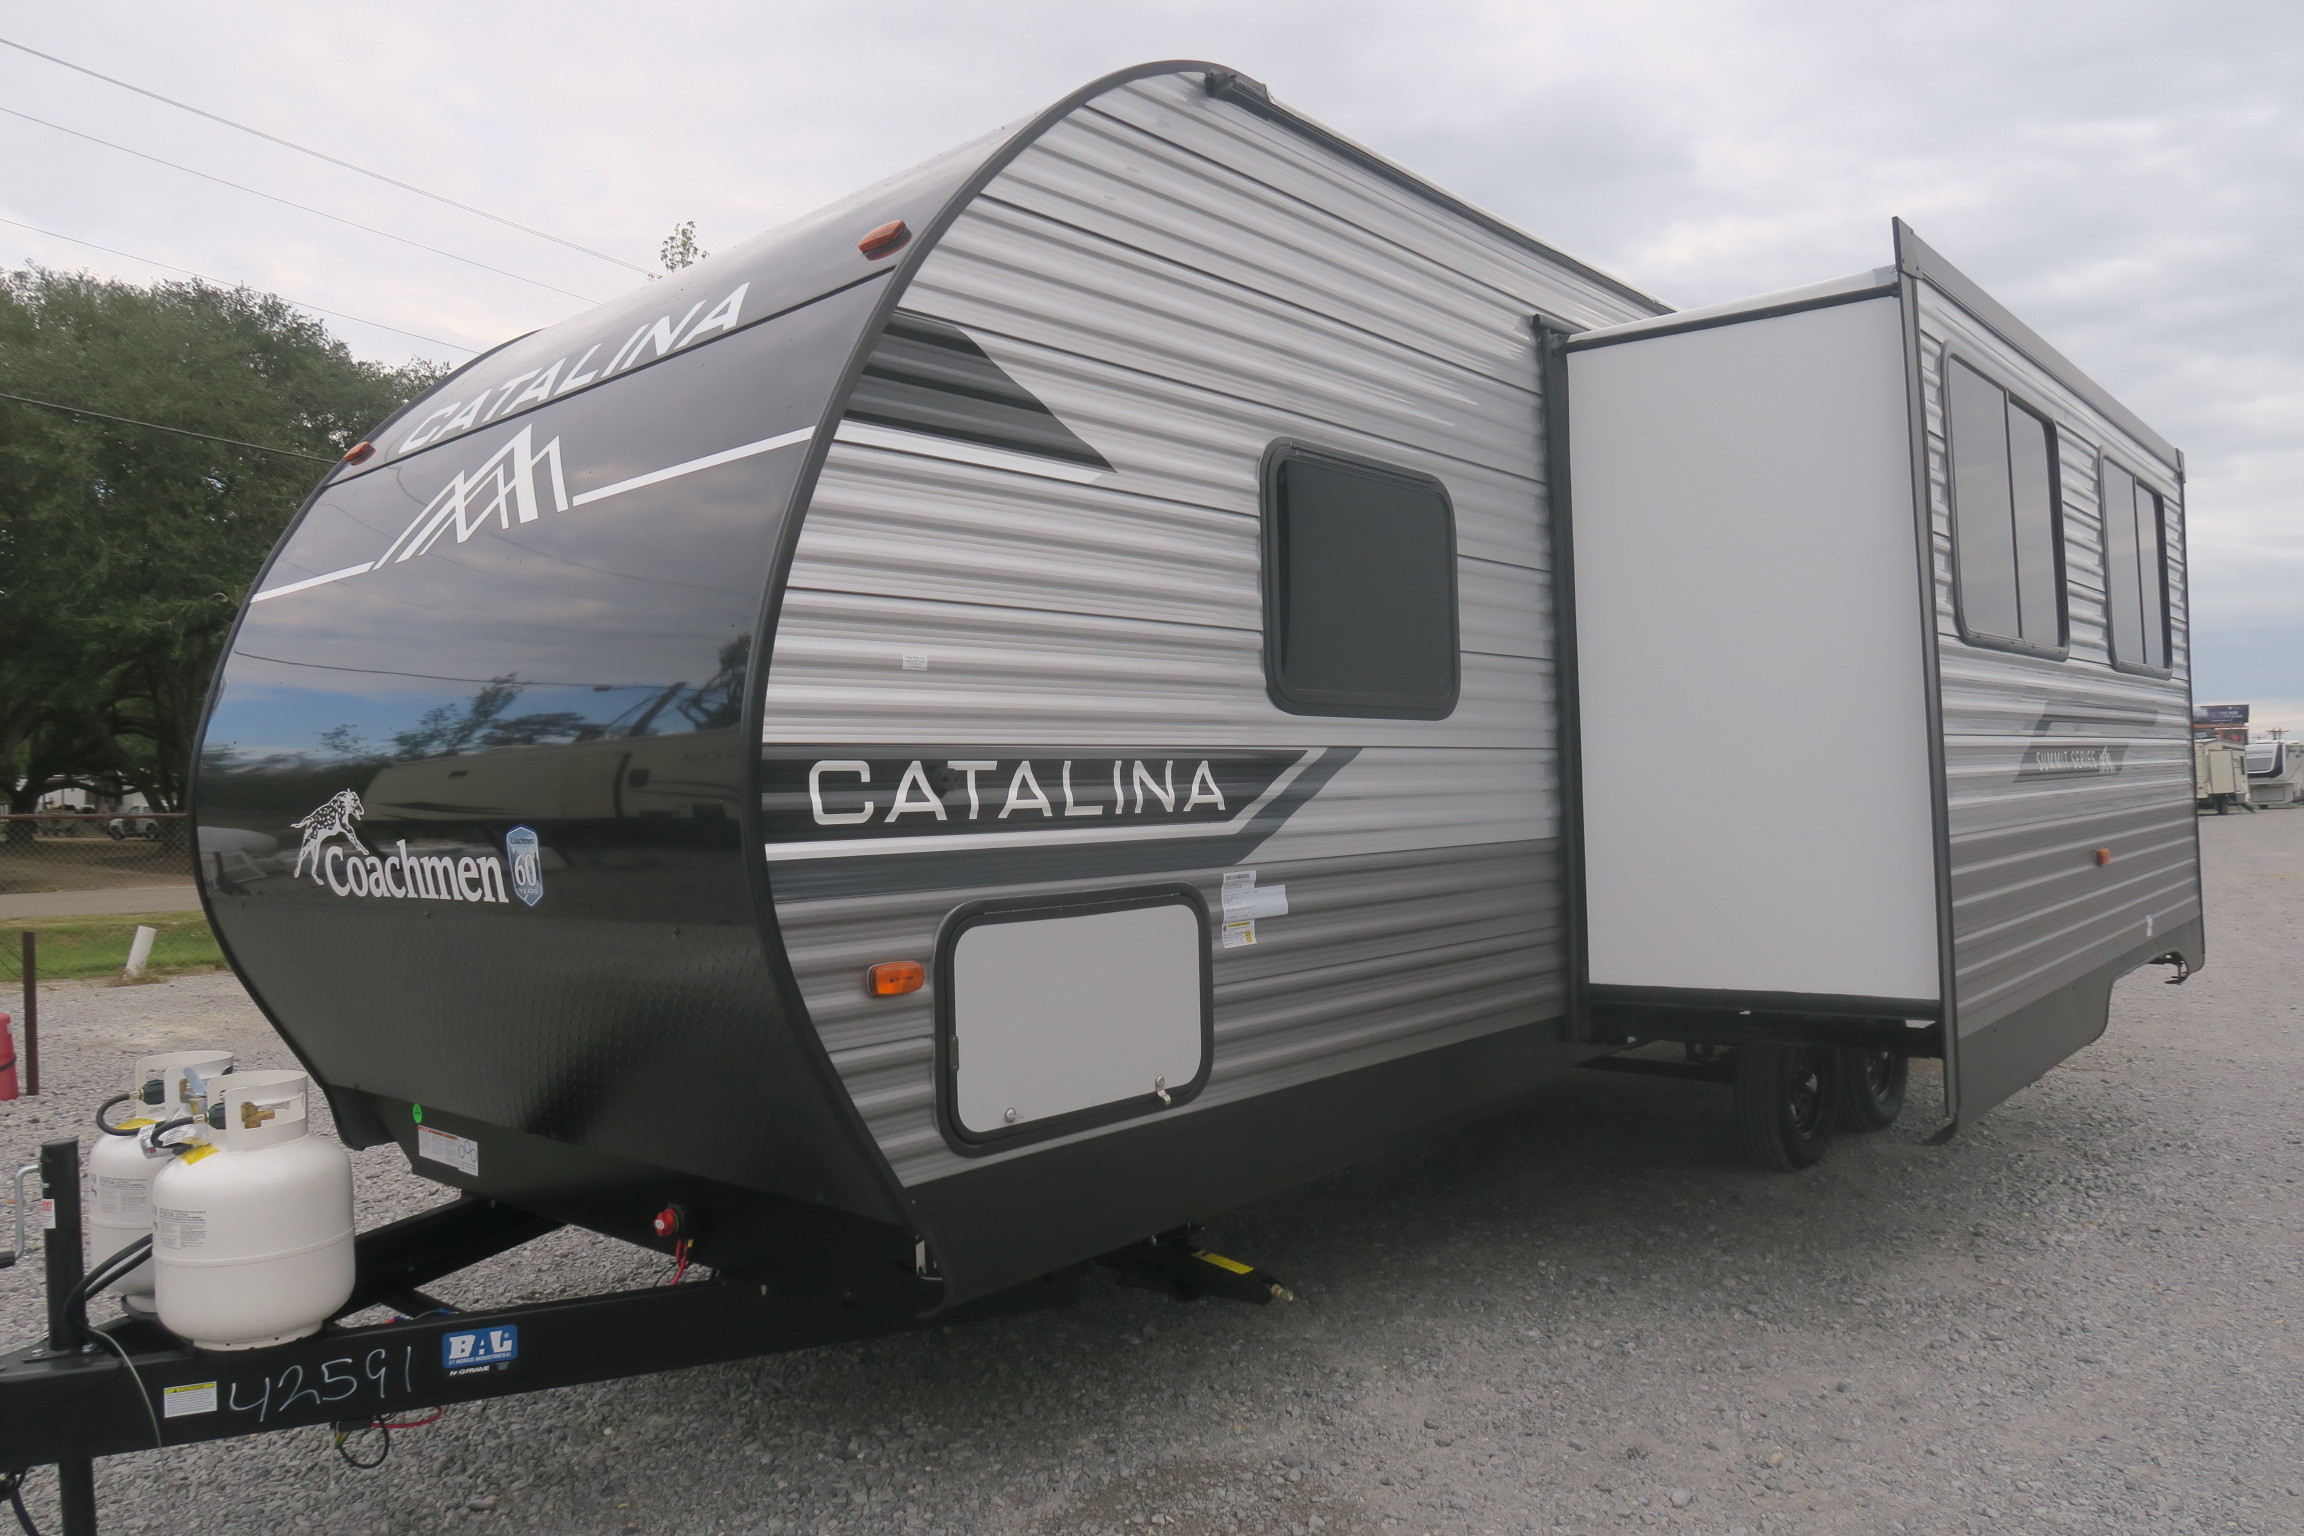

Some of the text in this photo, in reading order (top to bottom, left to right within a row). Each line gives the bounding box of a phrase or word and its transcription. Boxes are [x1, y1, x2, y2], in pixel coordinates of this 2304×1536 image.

[399, 281, 750, 454] CATALINA
[2070, 750, 2098, 769] SERIES
[808, 759, 1226, 826] CATALINA
[325, 839, 509, 903] Coachmen
[510, 837, 535, 845] Coachmen
[514, 853, 537, 887] 60
[229, 1346, 411, 1422] 42591
